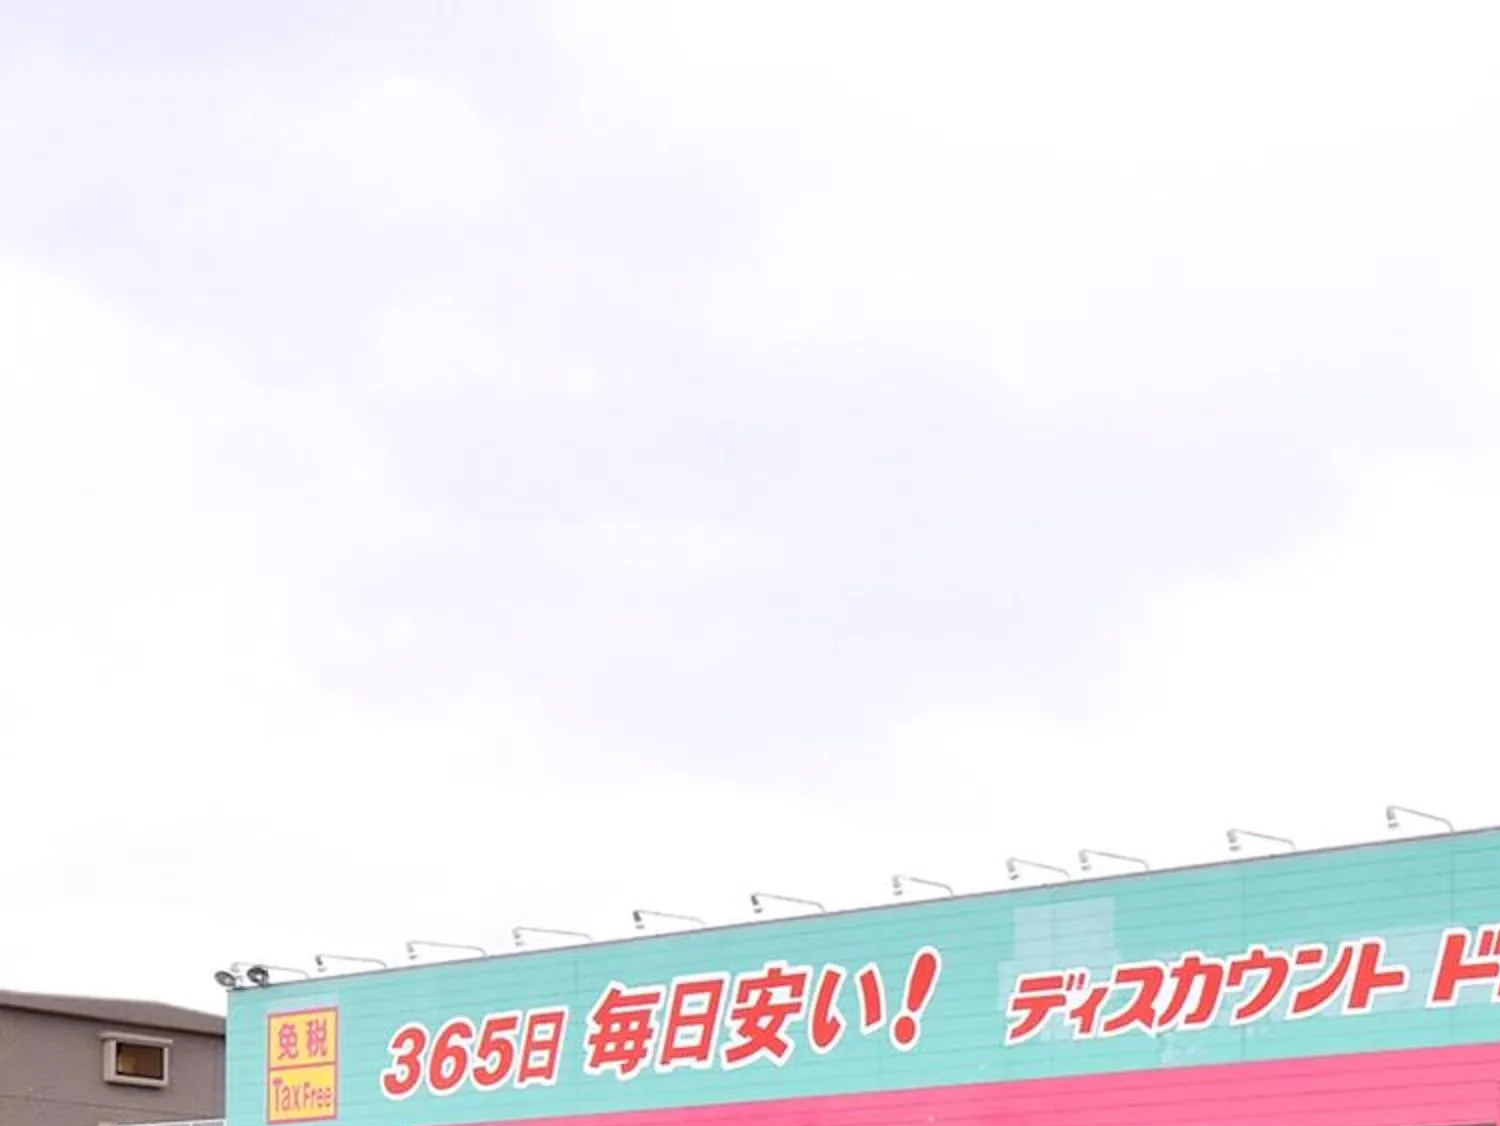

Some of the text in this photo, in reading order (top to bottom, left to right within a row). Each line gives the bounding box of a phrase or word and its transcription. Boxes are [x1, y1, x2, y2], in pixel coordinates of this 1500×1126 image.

[1005, 938, 1407, 1041] ディスカウント
[277, 1018, 328, 1060] 免税
[381, 1009, 568, 1096] 365日
